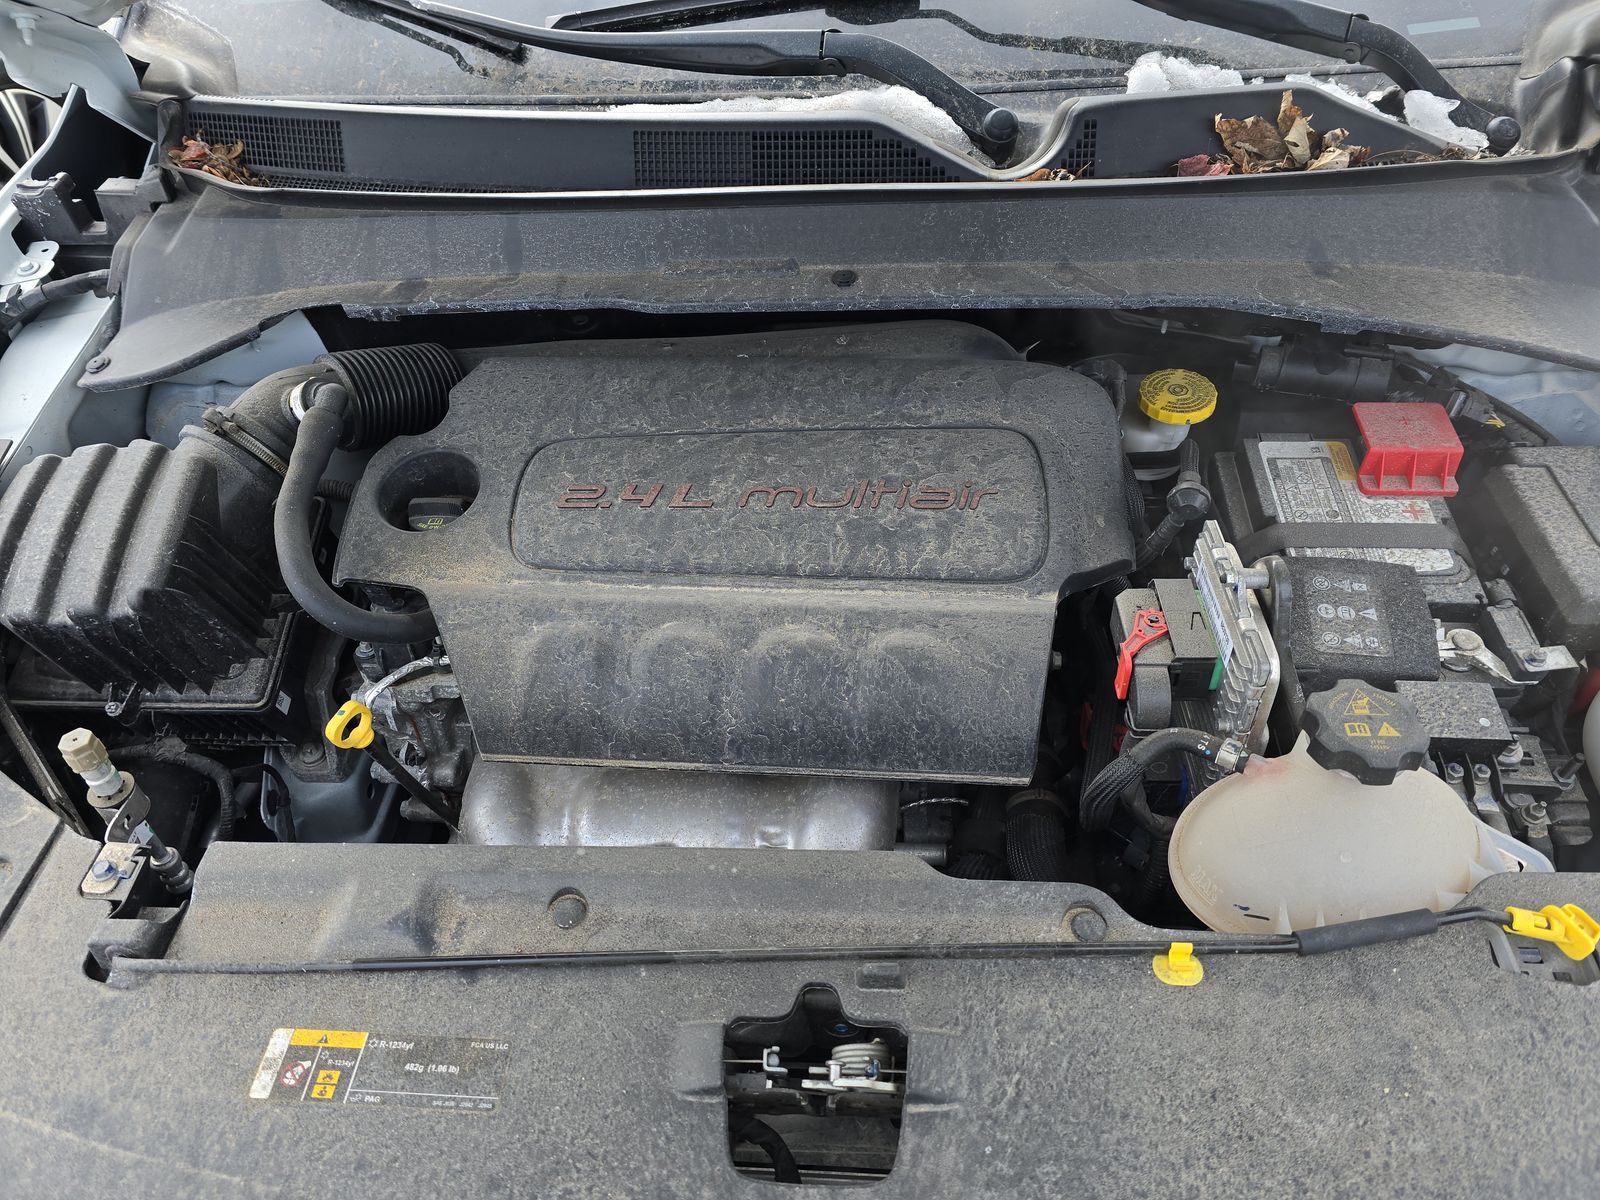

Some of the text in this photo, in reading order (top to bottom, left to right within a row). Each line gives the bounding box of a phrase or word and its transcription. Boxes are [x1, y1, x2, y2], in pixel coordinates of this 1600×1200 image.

[739, 479, 999, 510] multiair
[379, 1040, 415, 1051] R-1234yf
[470, 1041, 484, 1049] FCA
[404, 1062, 460, 1075] 482g (1.06 lb)
[364, 1095, 380, 1103] PAG
